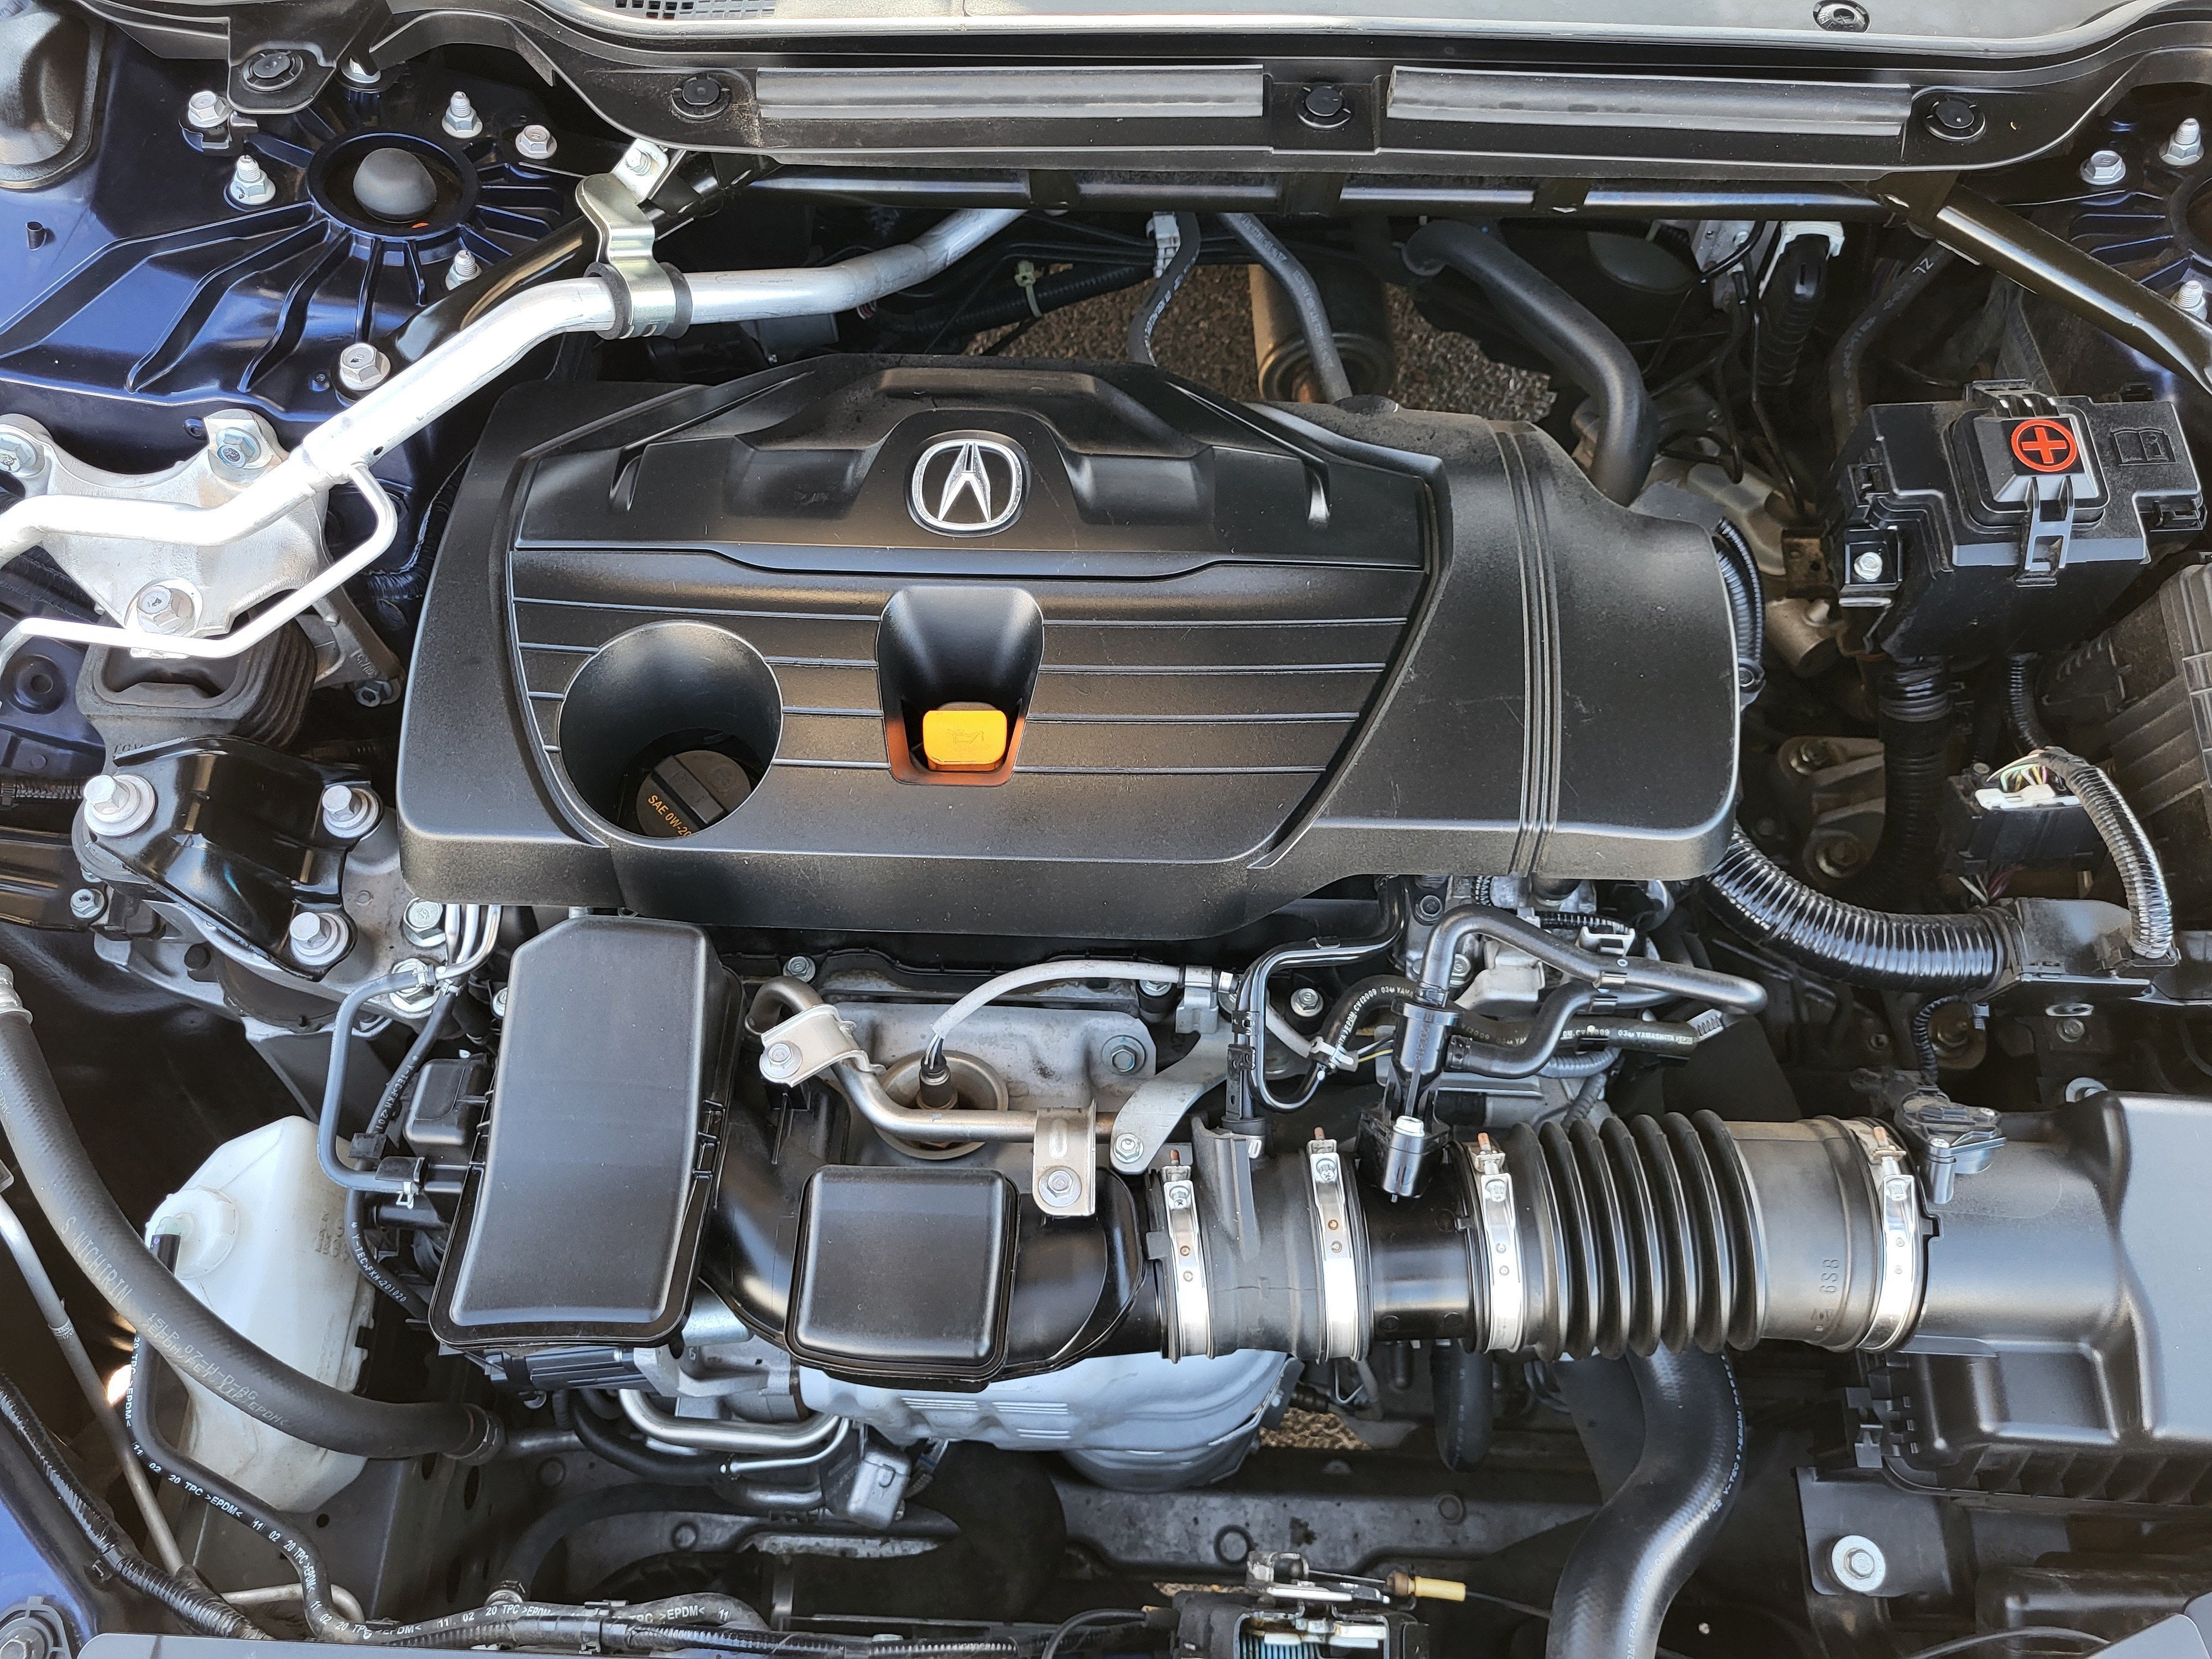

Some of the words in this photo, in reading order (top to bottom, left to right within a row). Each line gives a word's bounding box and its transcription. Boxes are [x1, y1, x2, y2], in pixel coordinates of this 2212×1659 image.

[648, 795, 669, 815] SAE
[169, 1474, 181, 1484] 20
[185, 1481, 203, 1495] TPC
[269, 1530, 280, 1542] 02
[283, 1540, 296, 1552] 20
[294, 1547, 309, 1564] TPC
[319, 1613, 332, 1625] 02
[335, 1621, 349, 1631] 20
[462, 1612, 474, 1622] 02
[486, 1606, 497, 1616] 20
[502, 1604, 518, 1615] TPC
